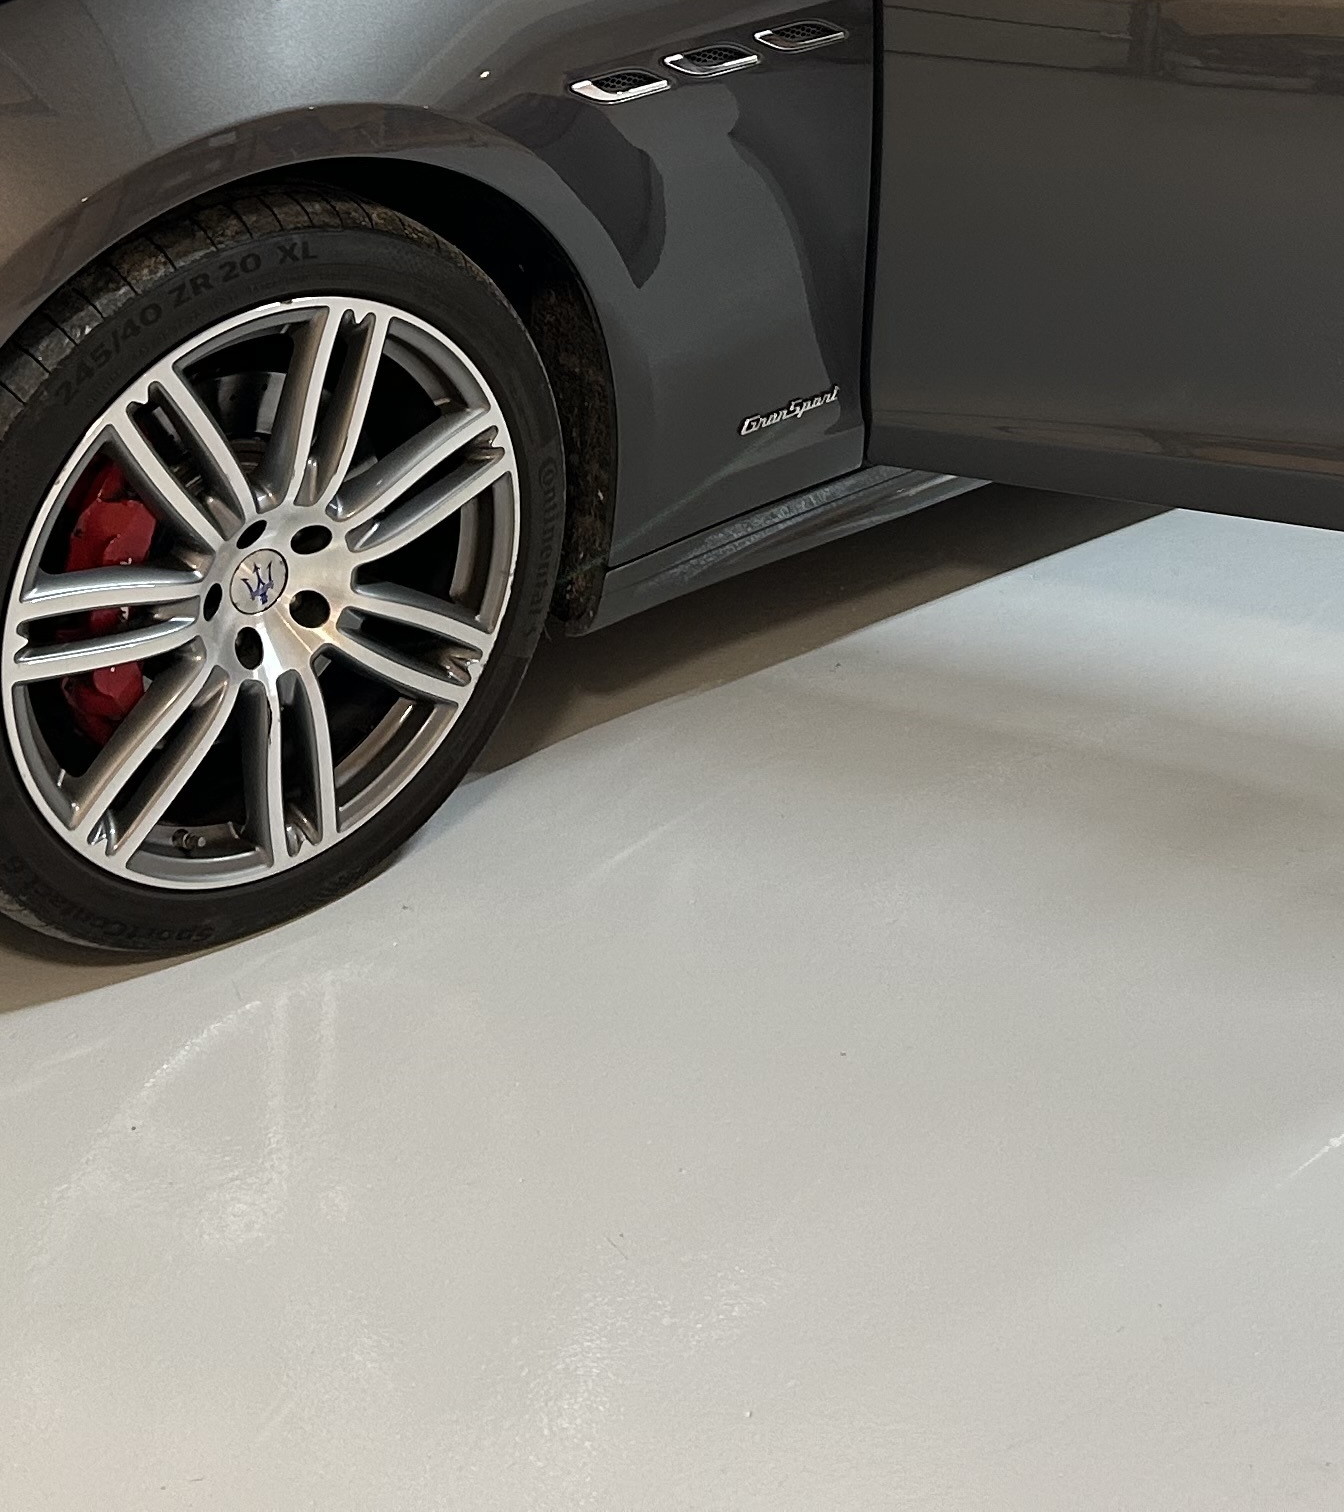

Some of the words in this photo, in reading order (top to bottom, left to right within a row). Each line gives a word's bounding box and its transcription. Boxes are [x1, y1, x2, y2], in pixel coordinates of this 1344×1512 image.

[54, 302, 162, 408] 245/40
[167, 272, 214, 310] ZR
[218, 252, 262, 284] 20
[277, 240, 319, 265] XL
